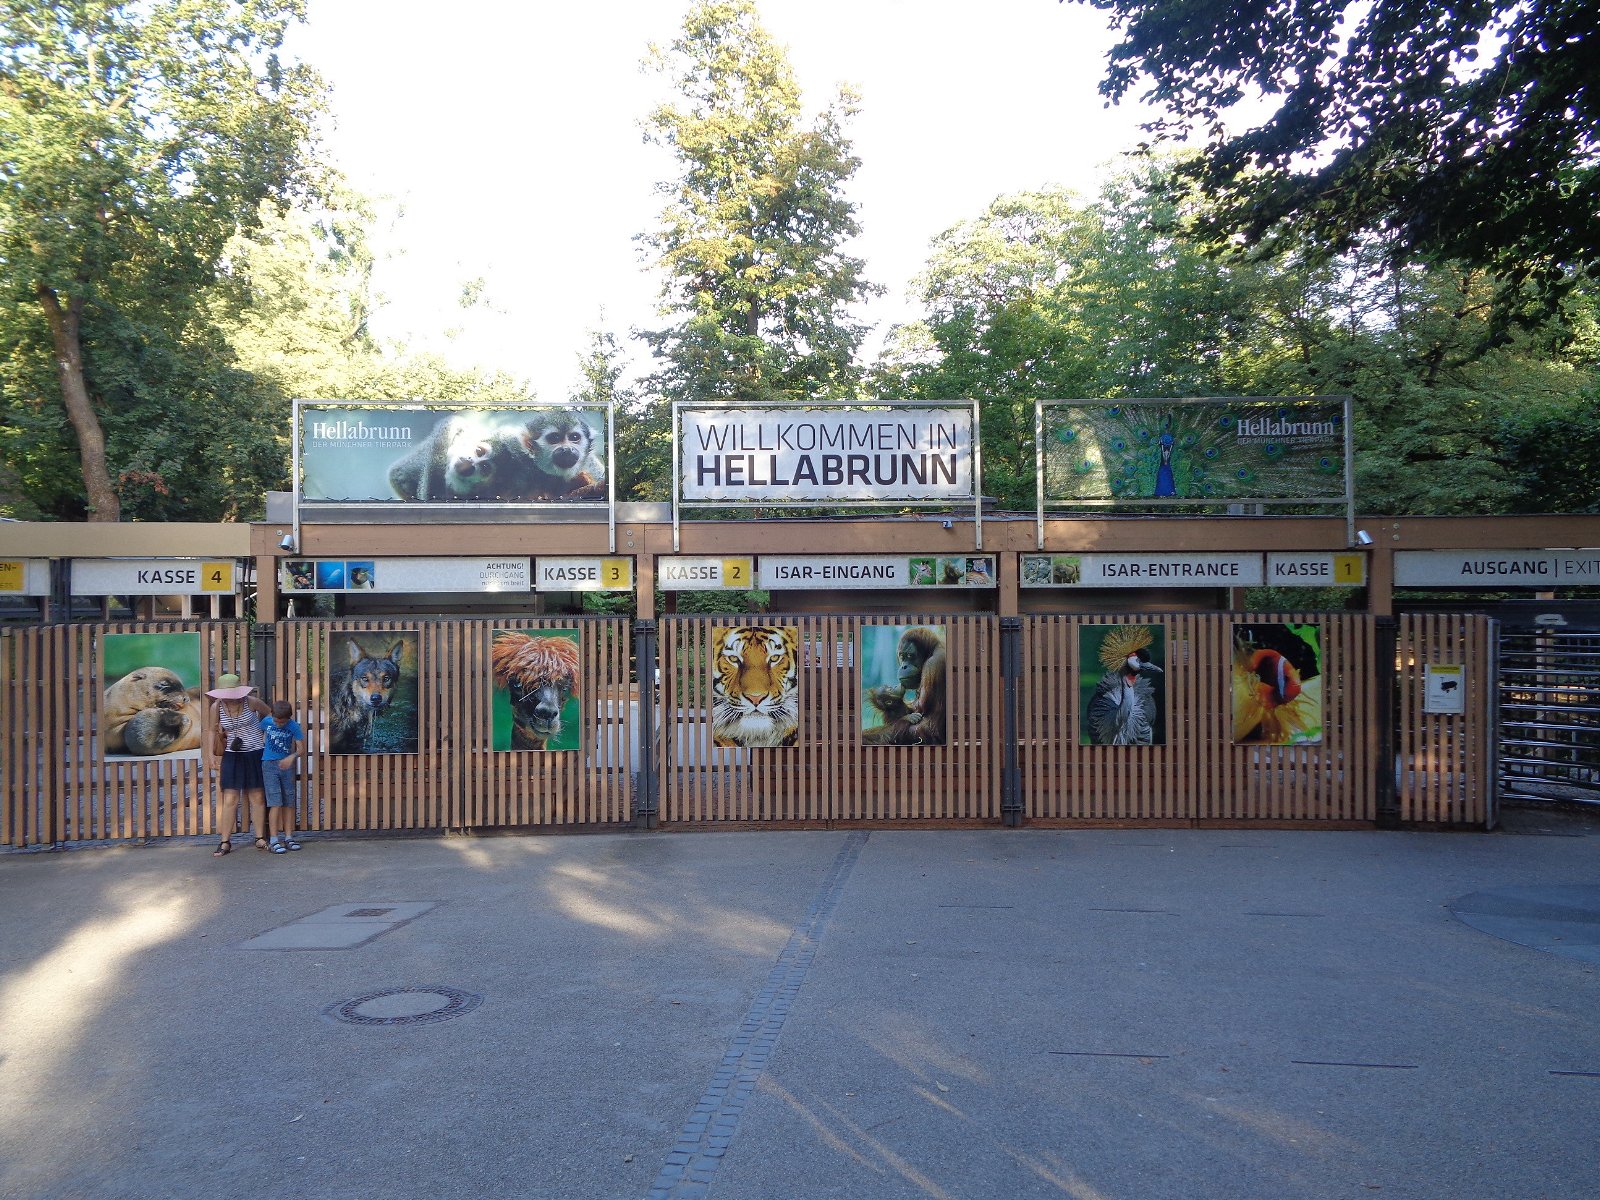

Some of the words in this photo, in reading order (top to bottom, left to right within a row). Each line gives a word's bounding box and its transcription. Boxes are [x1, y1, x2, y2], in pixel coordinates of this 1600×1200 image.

[313, 420, 412, 440] Hellabrunn
[1237, 417, 1334, 436] Hellabrunn
[696, 423, 917, 451] WILLKOMMEN
[929, 423, 957, 450] IN
[697, 453, 957, 486] HELLABRUNN
[486, 562, 524, 570] ACHTUNG!
[666, 566, 718, 580] KASSE
[732, 566, 741, 579] 2
[775, 565, 896, 579] ISAR-EINGANG
[1102, 563, 1240, 577] ISAR-ENTRANCE
[1276, 563, 1329, 576] KASSE
[1344, 563, 1352, 576] 1
[1461, 561, 1548, 575] AUSGANG
[1565, 560, 1600, 574] EXIT
[137, 570, 195, 584] KASSE
[211, 570, 222, 584] 4
[544, 567, 596, 580] KASSE
[611, 567, 620, 580] 3
